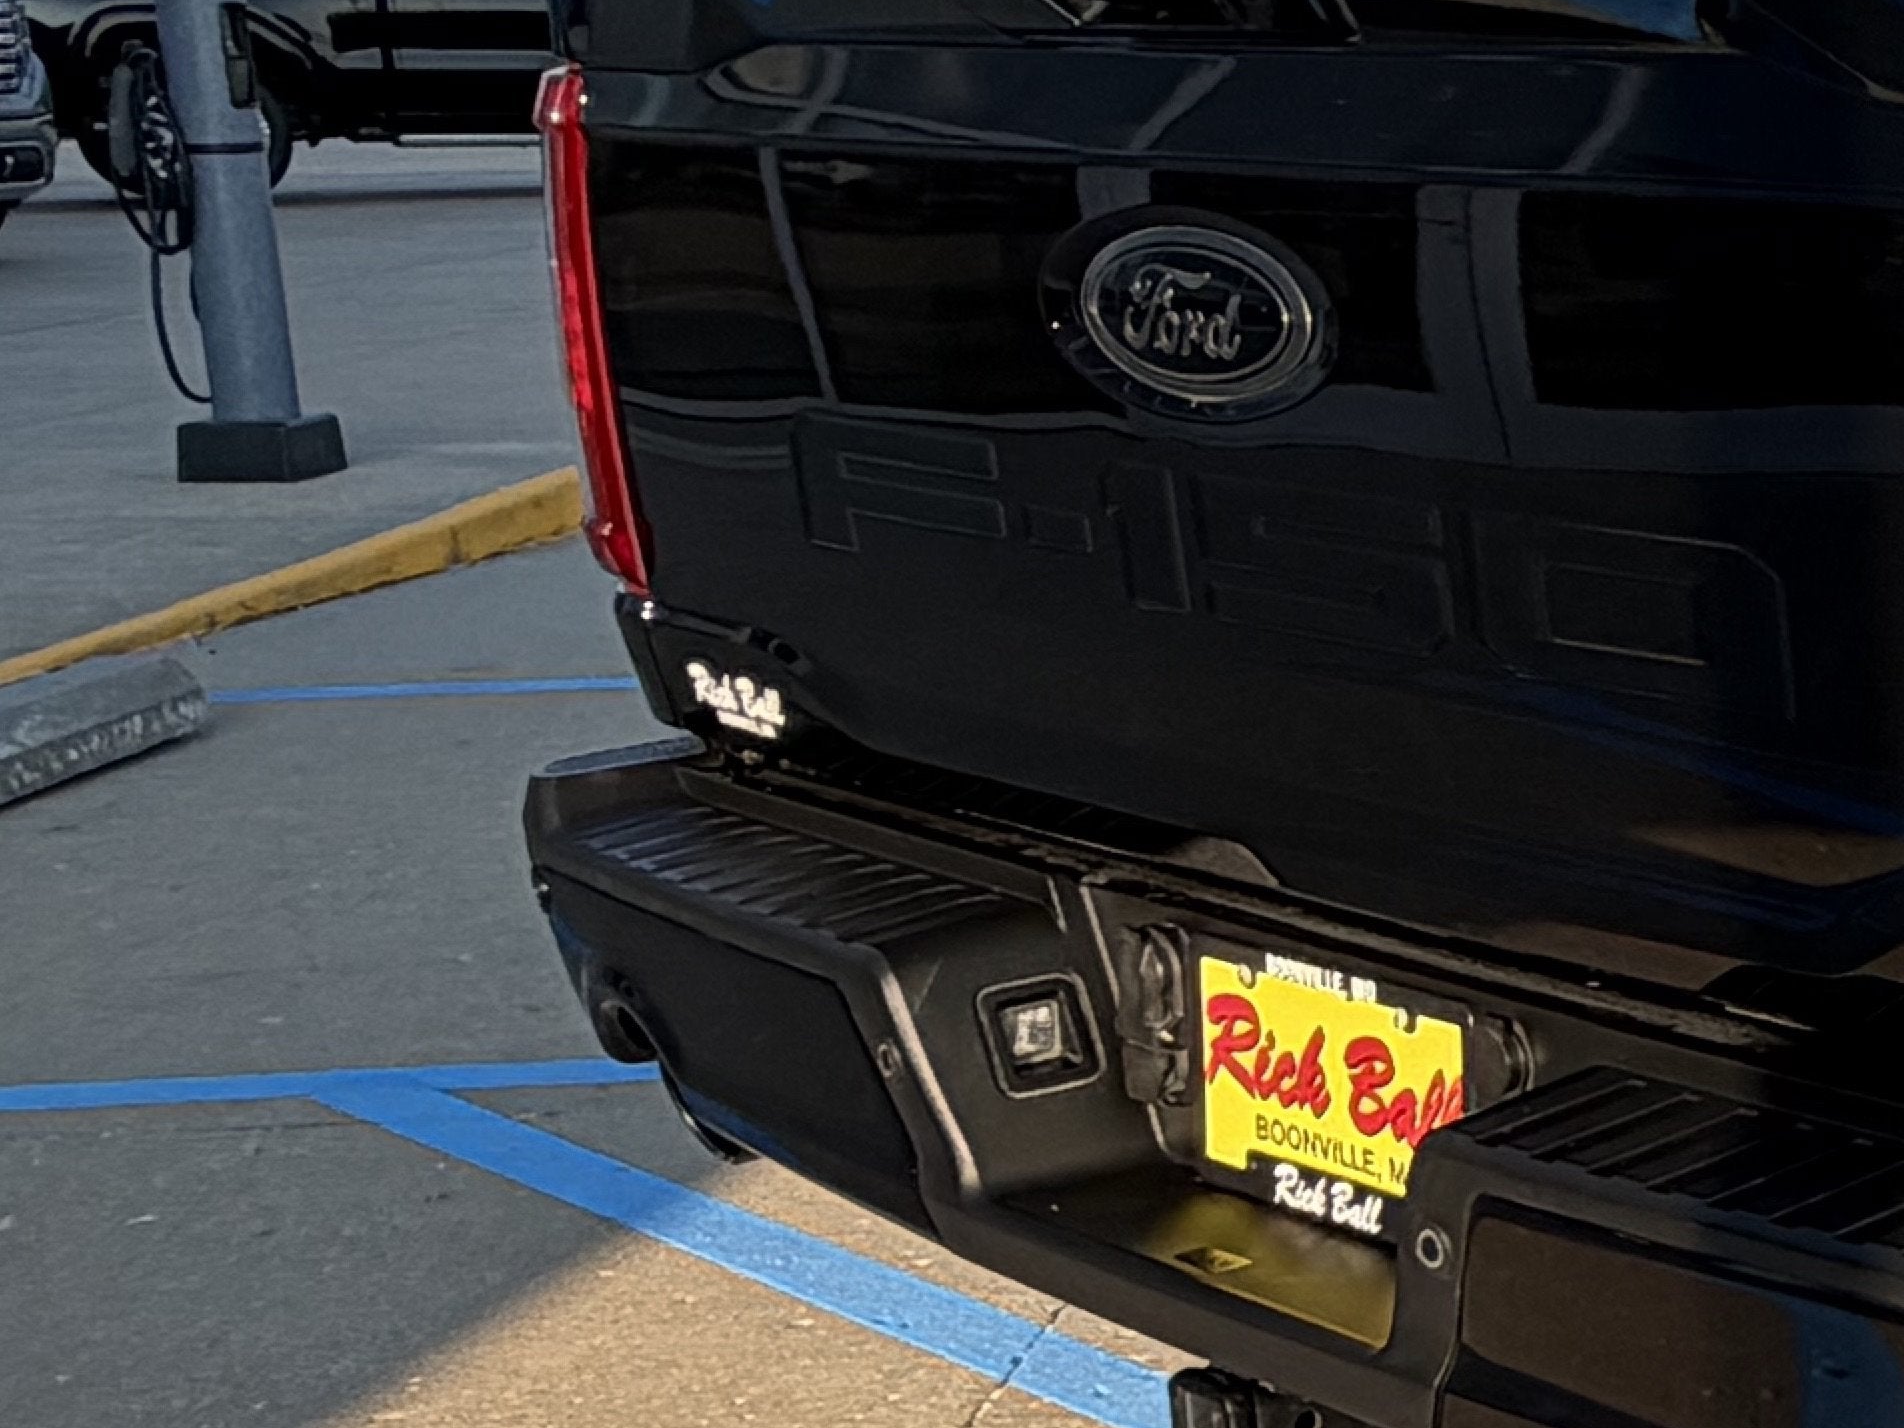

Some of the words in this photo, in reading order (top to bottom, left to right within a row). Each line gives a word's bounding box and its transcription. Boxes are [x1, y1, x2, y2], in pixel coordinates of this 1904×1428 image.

[1123, 264, 1242, 360] Ford
[792, 410, 1797, 722] F-150
[1205, 993, 1331, 1119] Rick
[1345, 1036, 1464, 1148] Ball
[1256, 1113, 1381, 1183] BOONVILLE,
[1273, 1162, 1327, 1217] Rick
[1330, 1183, 1383, 1233] Ball
